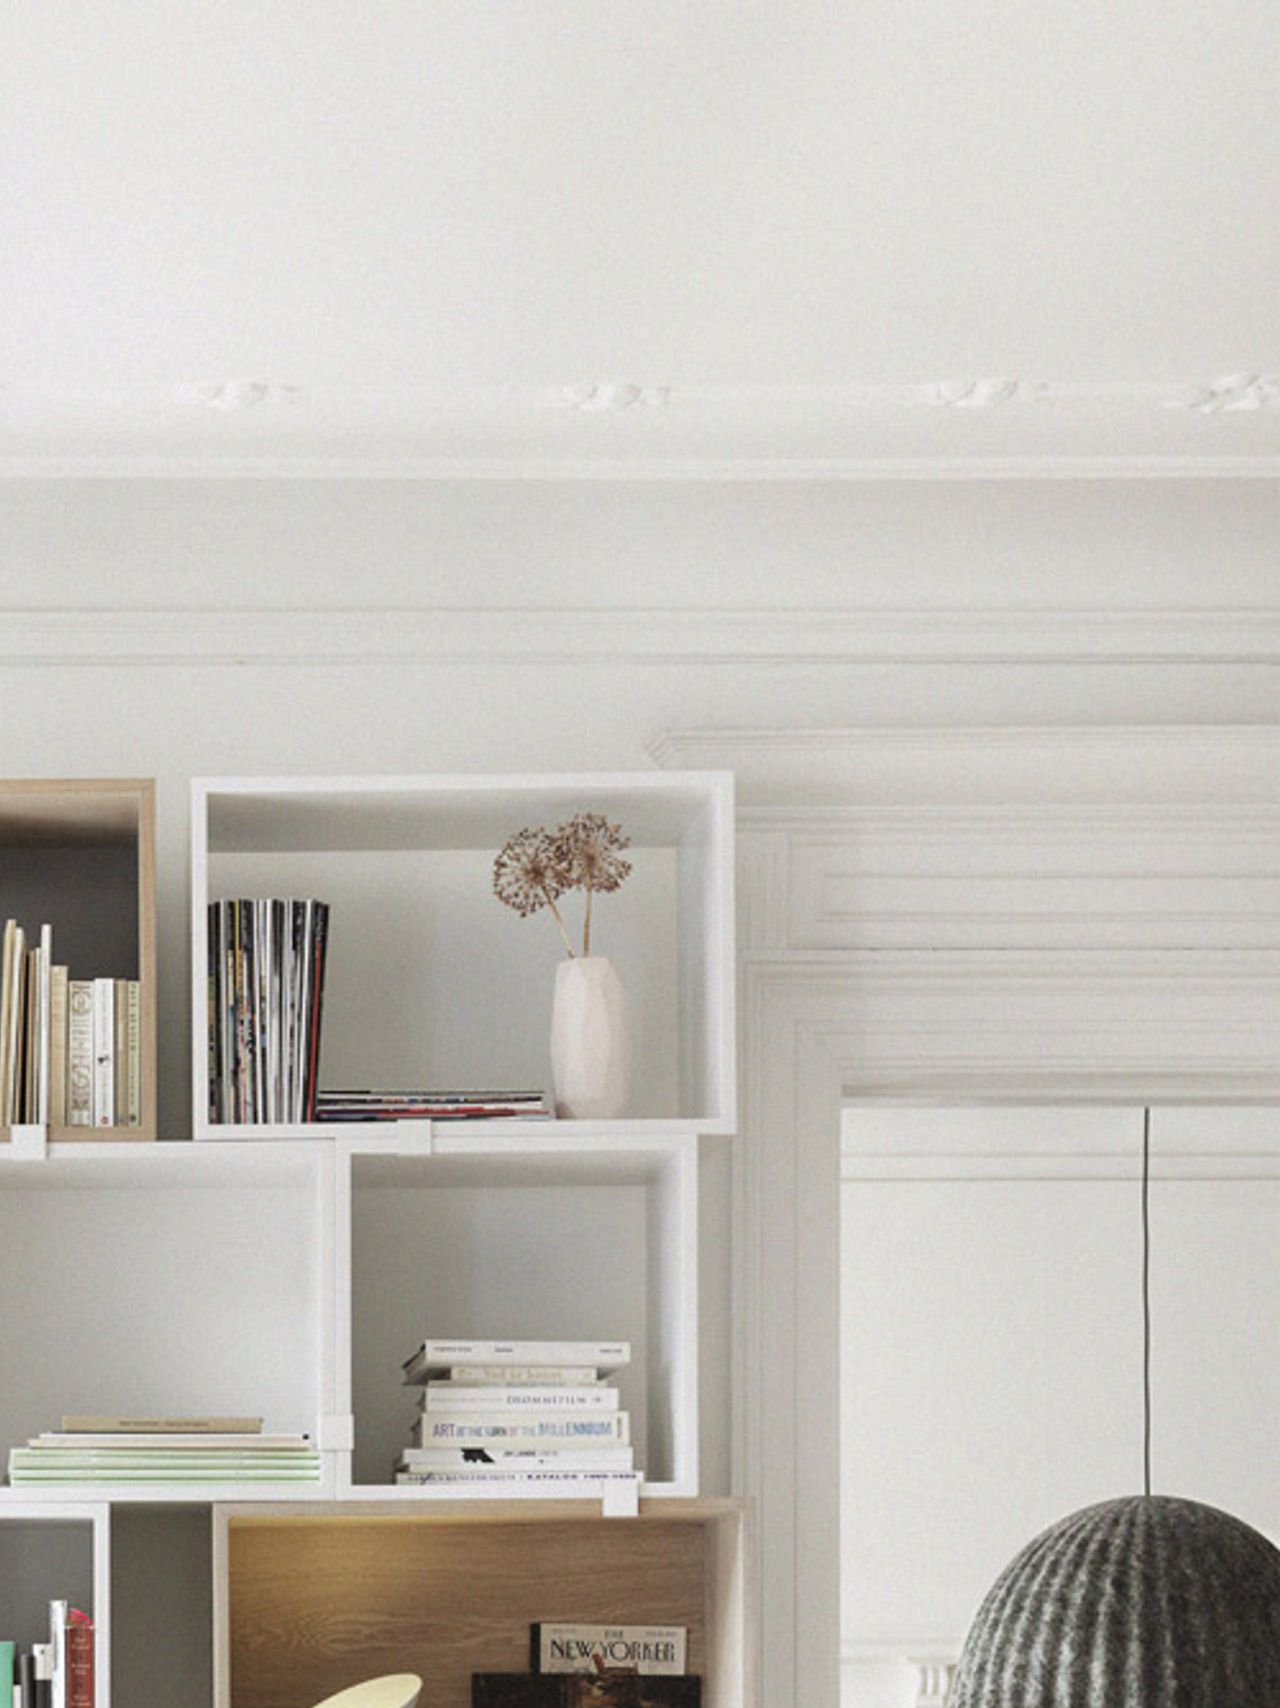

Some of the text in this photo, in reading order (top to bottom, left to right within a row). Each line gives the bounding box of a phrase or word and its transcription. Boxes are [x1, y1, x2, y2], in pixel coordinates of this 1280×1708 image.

[432, 1423, 455, 1438] ART
[538, 1421, 613, 1437] MILLENNIUM
[549, 1638, 676, 1663] NEW YORKER
